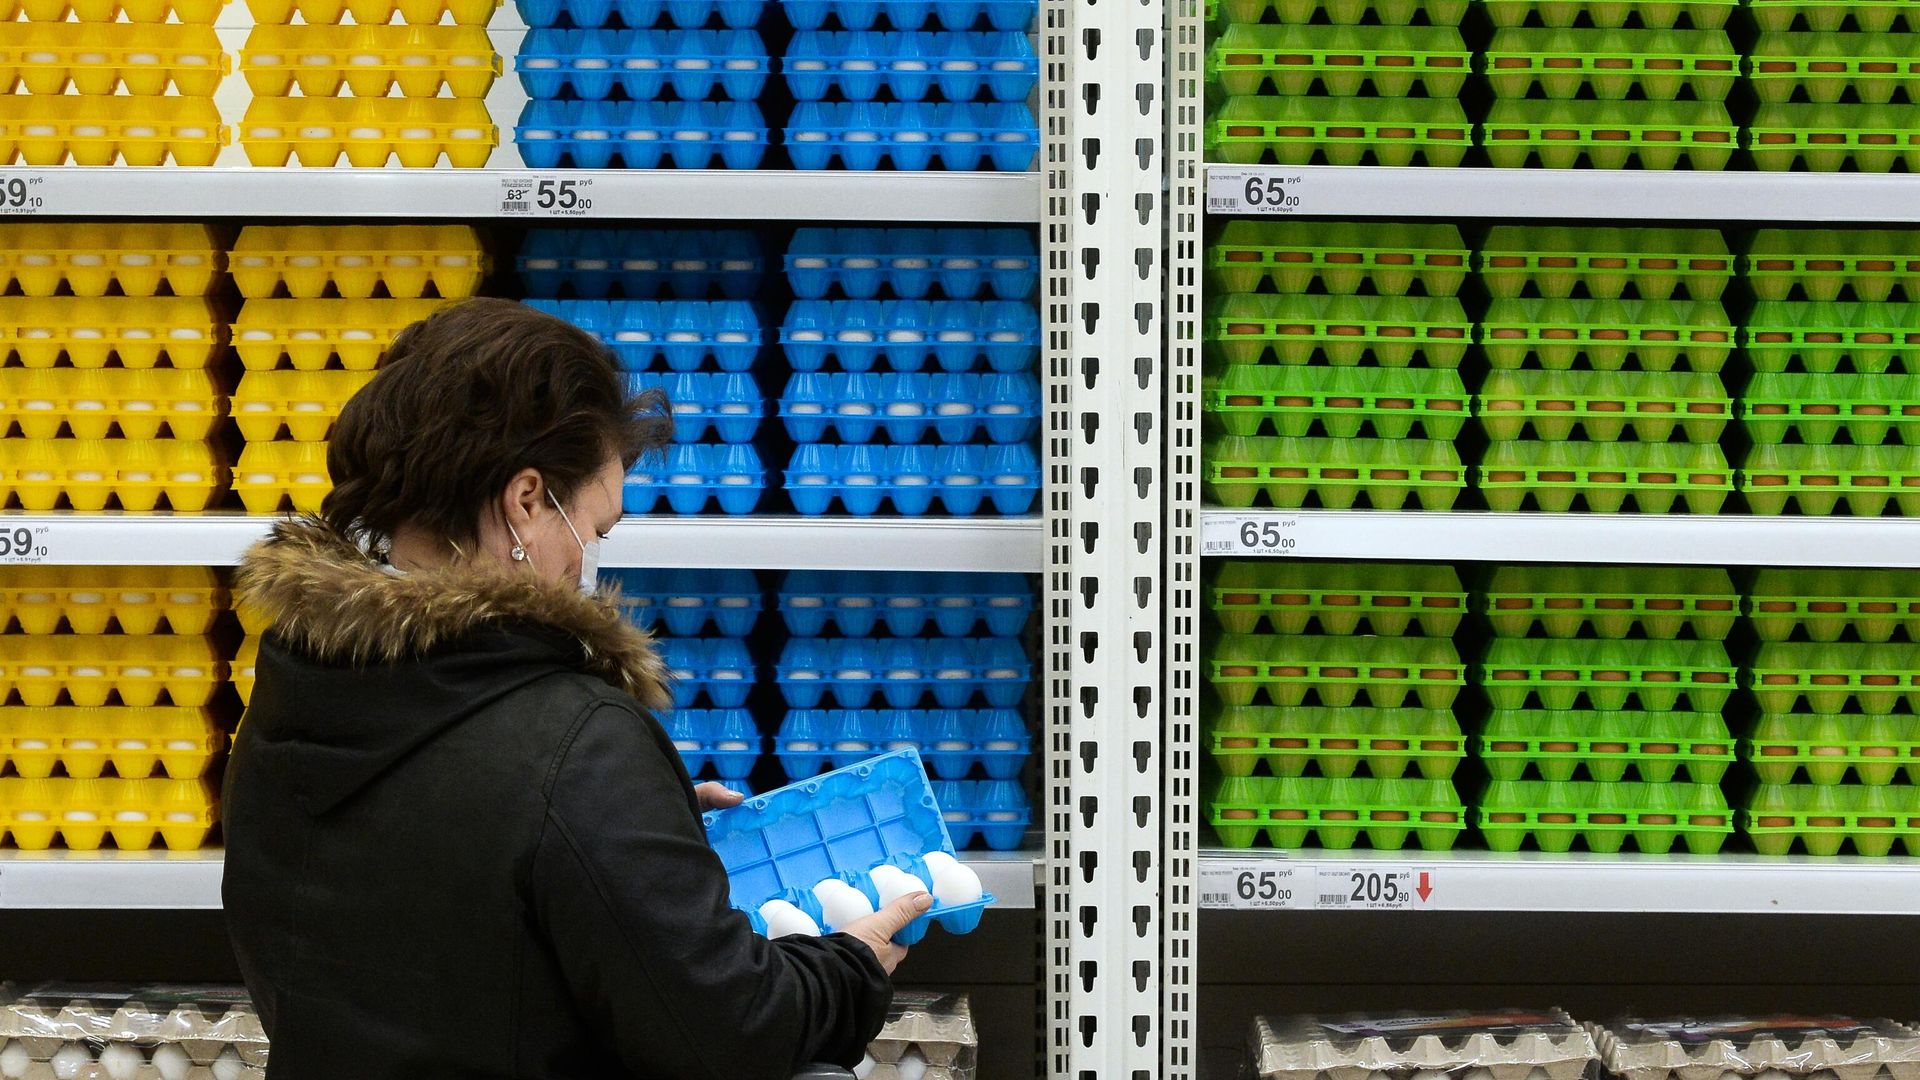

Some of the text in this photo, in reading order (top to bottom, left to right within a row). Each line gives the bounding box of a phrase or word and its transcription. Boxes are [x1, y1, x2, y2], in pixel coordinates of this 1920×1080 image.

[29, 176, 43, 185] руб
[579, 178, 593, 186] руб
[1287, 176, 1301, 184] руб
[507, 189, 522, 200] 63
[537, 180, 592, 209] 55 00
[1245, 176, 1300, 206] 65 00
[29, 197, 42, 207] 10
[1240, 521, 1296, 548] 65 00
[0, 527, 48, 556] 59 10
[1279, 870, 1293, 878] руб
[1399, 872, 1410, 880] руб
[1237, 871, 1292, 900] 65 00
[1350, 872, 1409, 902] 205 90
